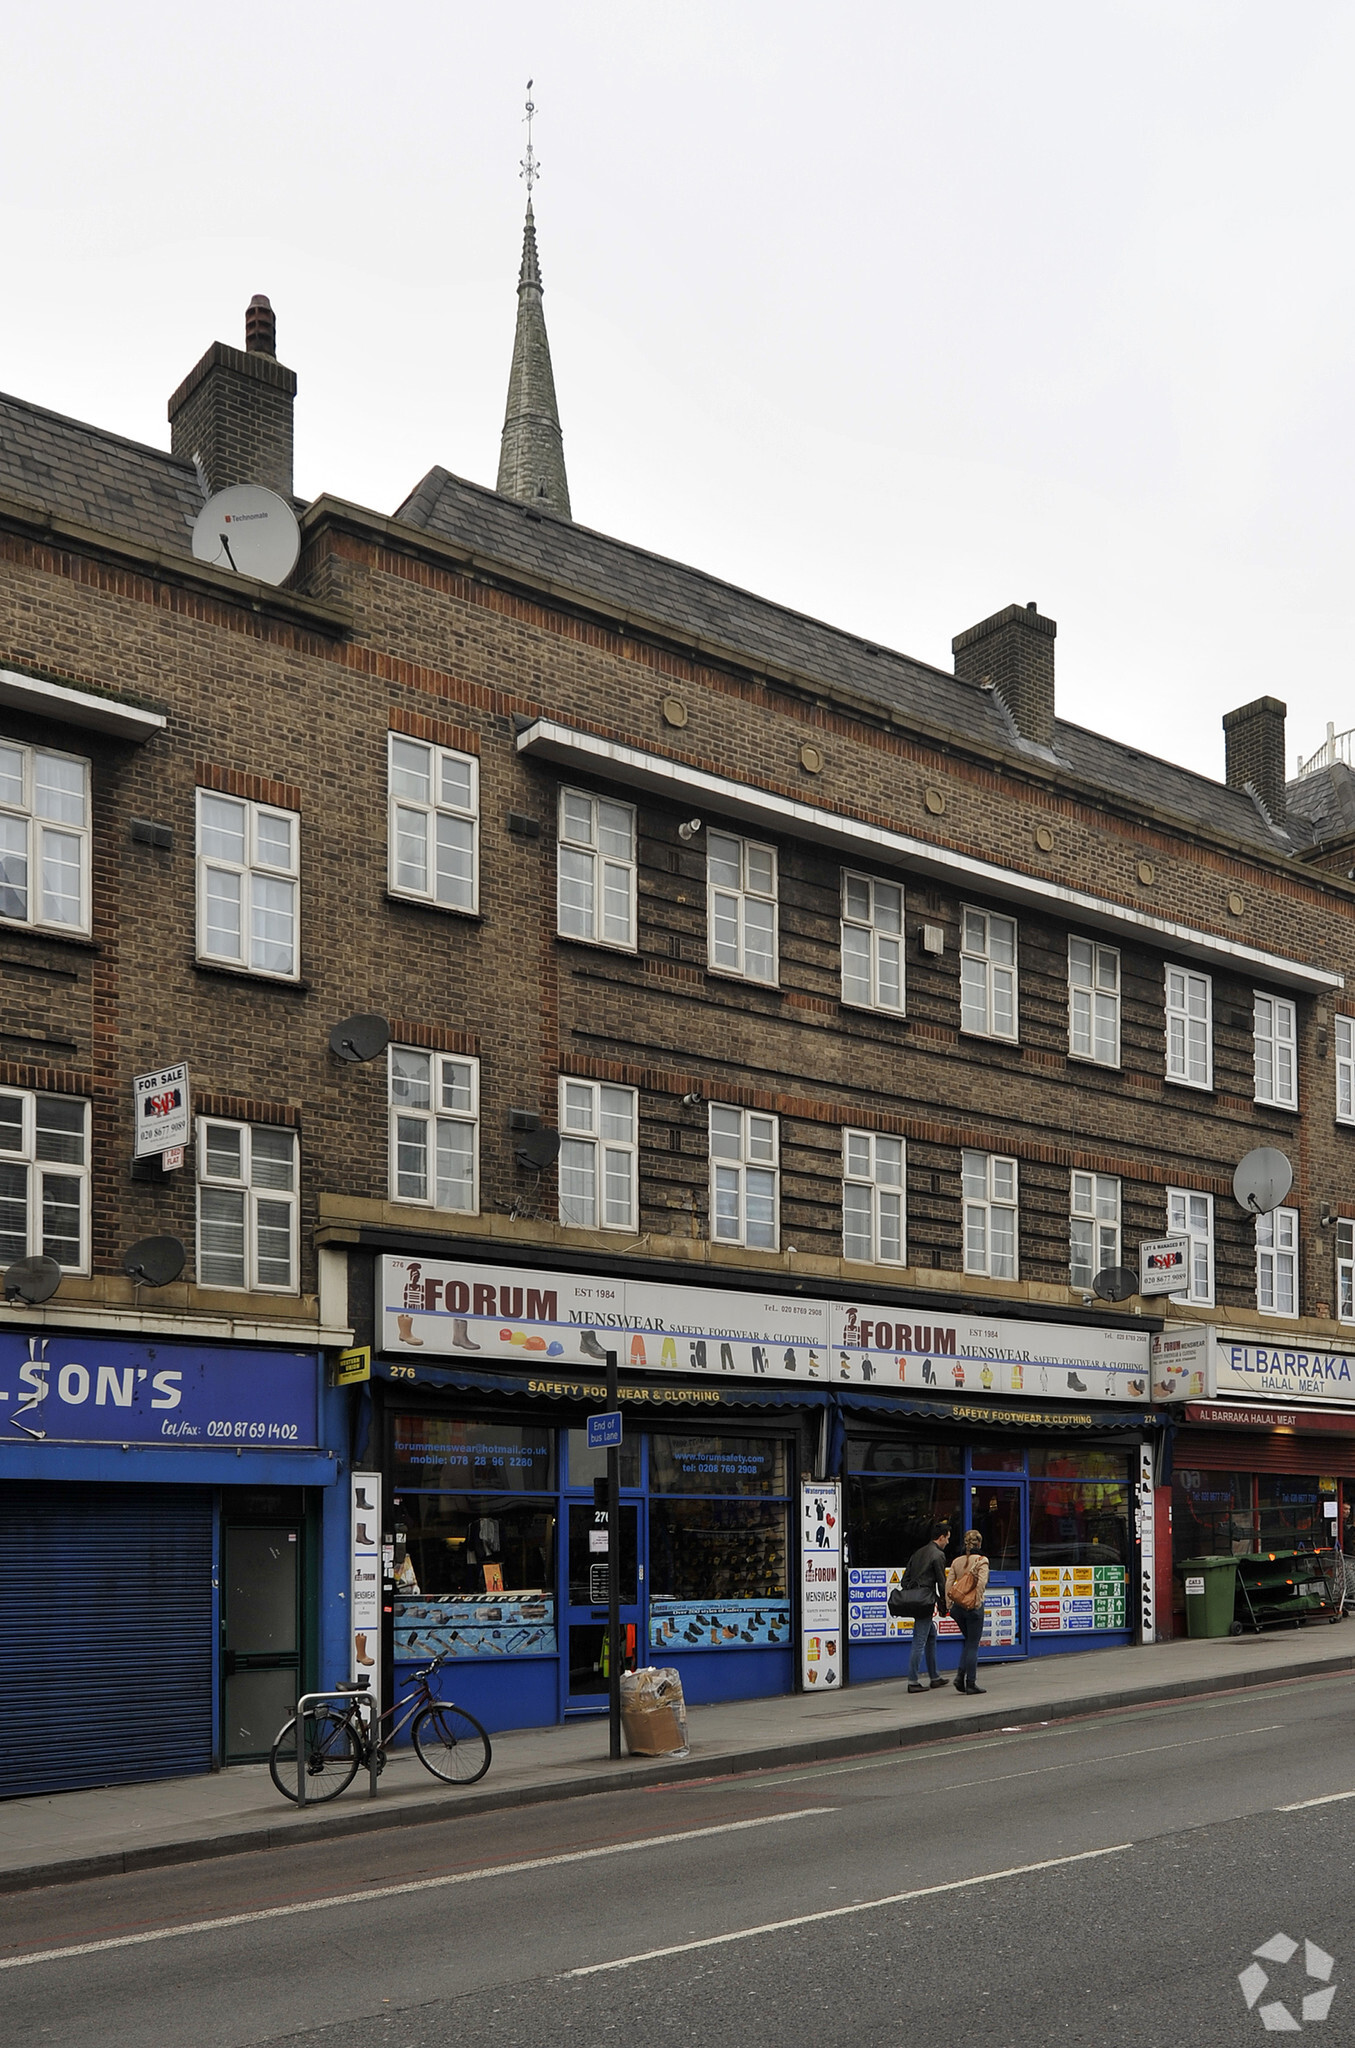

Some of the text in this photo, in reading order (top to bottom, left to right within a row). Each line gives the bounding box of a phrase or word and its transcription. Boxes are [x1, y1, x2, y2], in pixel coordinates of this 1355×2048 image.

[232, 512, 268, 522] Technomate
[138, 1069, 183, 1091] FOR SALE
[140, 1130, 152, 1140] 020
[154, 1125, 169, 1137] 8677
[167, 1156, 180, 1165] FLAT
[1156, 1275, 1170, 1283] 8677
[574, 1288, 615, 1299] EST 1984
[425, 1278, 558, 1322] FORUM
[781, 1305, 792, 1313] 020
[793, 1306, 807, 1314] 8769
[808, 1307, 822, 1316] 2908
[568, 1310, 664, 1332] MENSWEAR
[669, 1323, 706, 1335] SAFETY
[708, 1327, 760, 1341] FOOTWEAR
[773, 1333, 819, 1345] CLOTHING
[860, 1320, 956, 1355] FORUM
[969, 1329, 998, 1339] EST 1984
[960, 1345, 1030, 1362] MENSWEAR
[1034, 1355, 1060, 1364] SAFETY
[1062, 1357, 1100, 1368] FOOTWEAR
[1109, 1362, 1143, 1370] CLOTHING
[1231, 1347, 1351, 1381] ELBARRAKA
[390, 1366, 416, 1379] 276
[0, 1361, 182, 1409] SON'S
[1261, 1376, 1325, 1393] HALAL MEAT
[528, 1381, 720, 1401] SAFETY FOOWEAR & CLOTHING
[953, 1406, 989, 1419] SAFETY
[992, 1411, 1042, 1423] FOOTWEAR
[1052, 1415, 1092, 1424] CLOTHING
[1144, 1415, 1156, 1424] 274
[1200, 1410, 1296, 1425] AL BARRAKA HALAL MEAT
[593, 1419, 615, 1431] End of
[590, 1430, 618, 1442] bus lane
[410, 1455, 447, 1465] mobile:
[450, 1456, 468, 1465] 078
[474, 1457, 486, 1465] 28
[509, 1458, 533, 1467] 2280
[674, 1453, 764, 1464] www.forumsafety.com
[682, 1464, 757, 1474] tel: 0208 769 2908
[815, 1567, 837, 1582] FORUM
[805, 1591, 837, 1602] MENSWEAR
[850, 1590, 886, 1599] Site office
